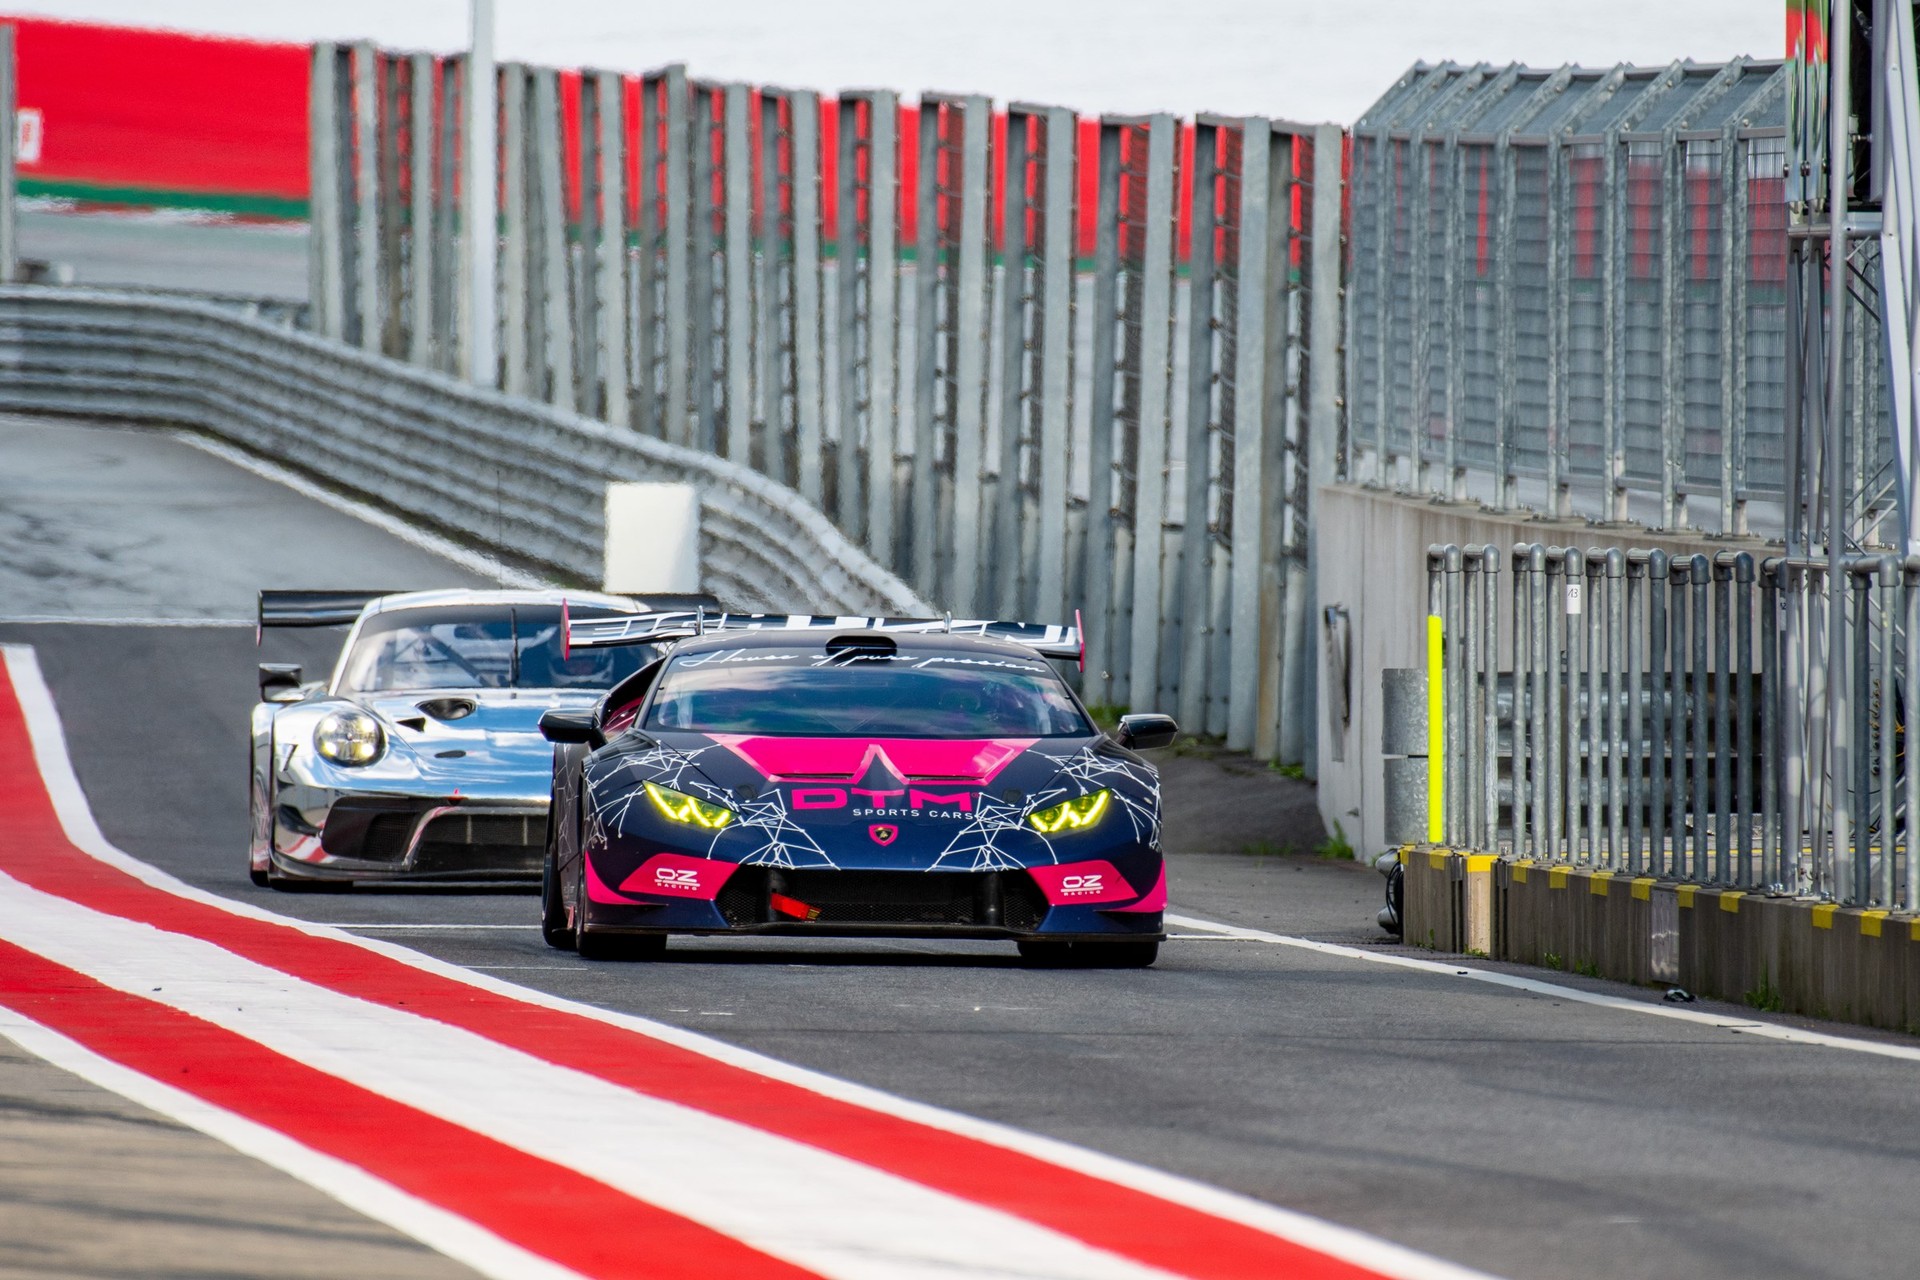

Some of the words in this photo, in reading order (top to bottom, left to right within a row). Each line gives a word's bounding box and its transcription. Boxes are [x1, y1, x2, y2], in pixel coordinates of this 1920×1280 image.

[791, 787, 972, 812] DTM
[852, 808, 920, 817] SPORTS
[928, 810, 974, 820] CARS
